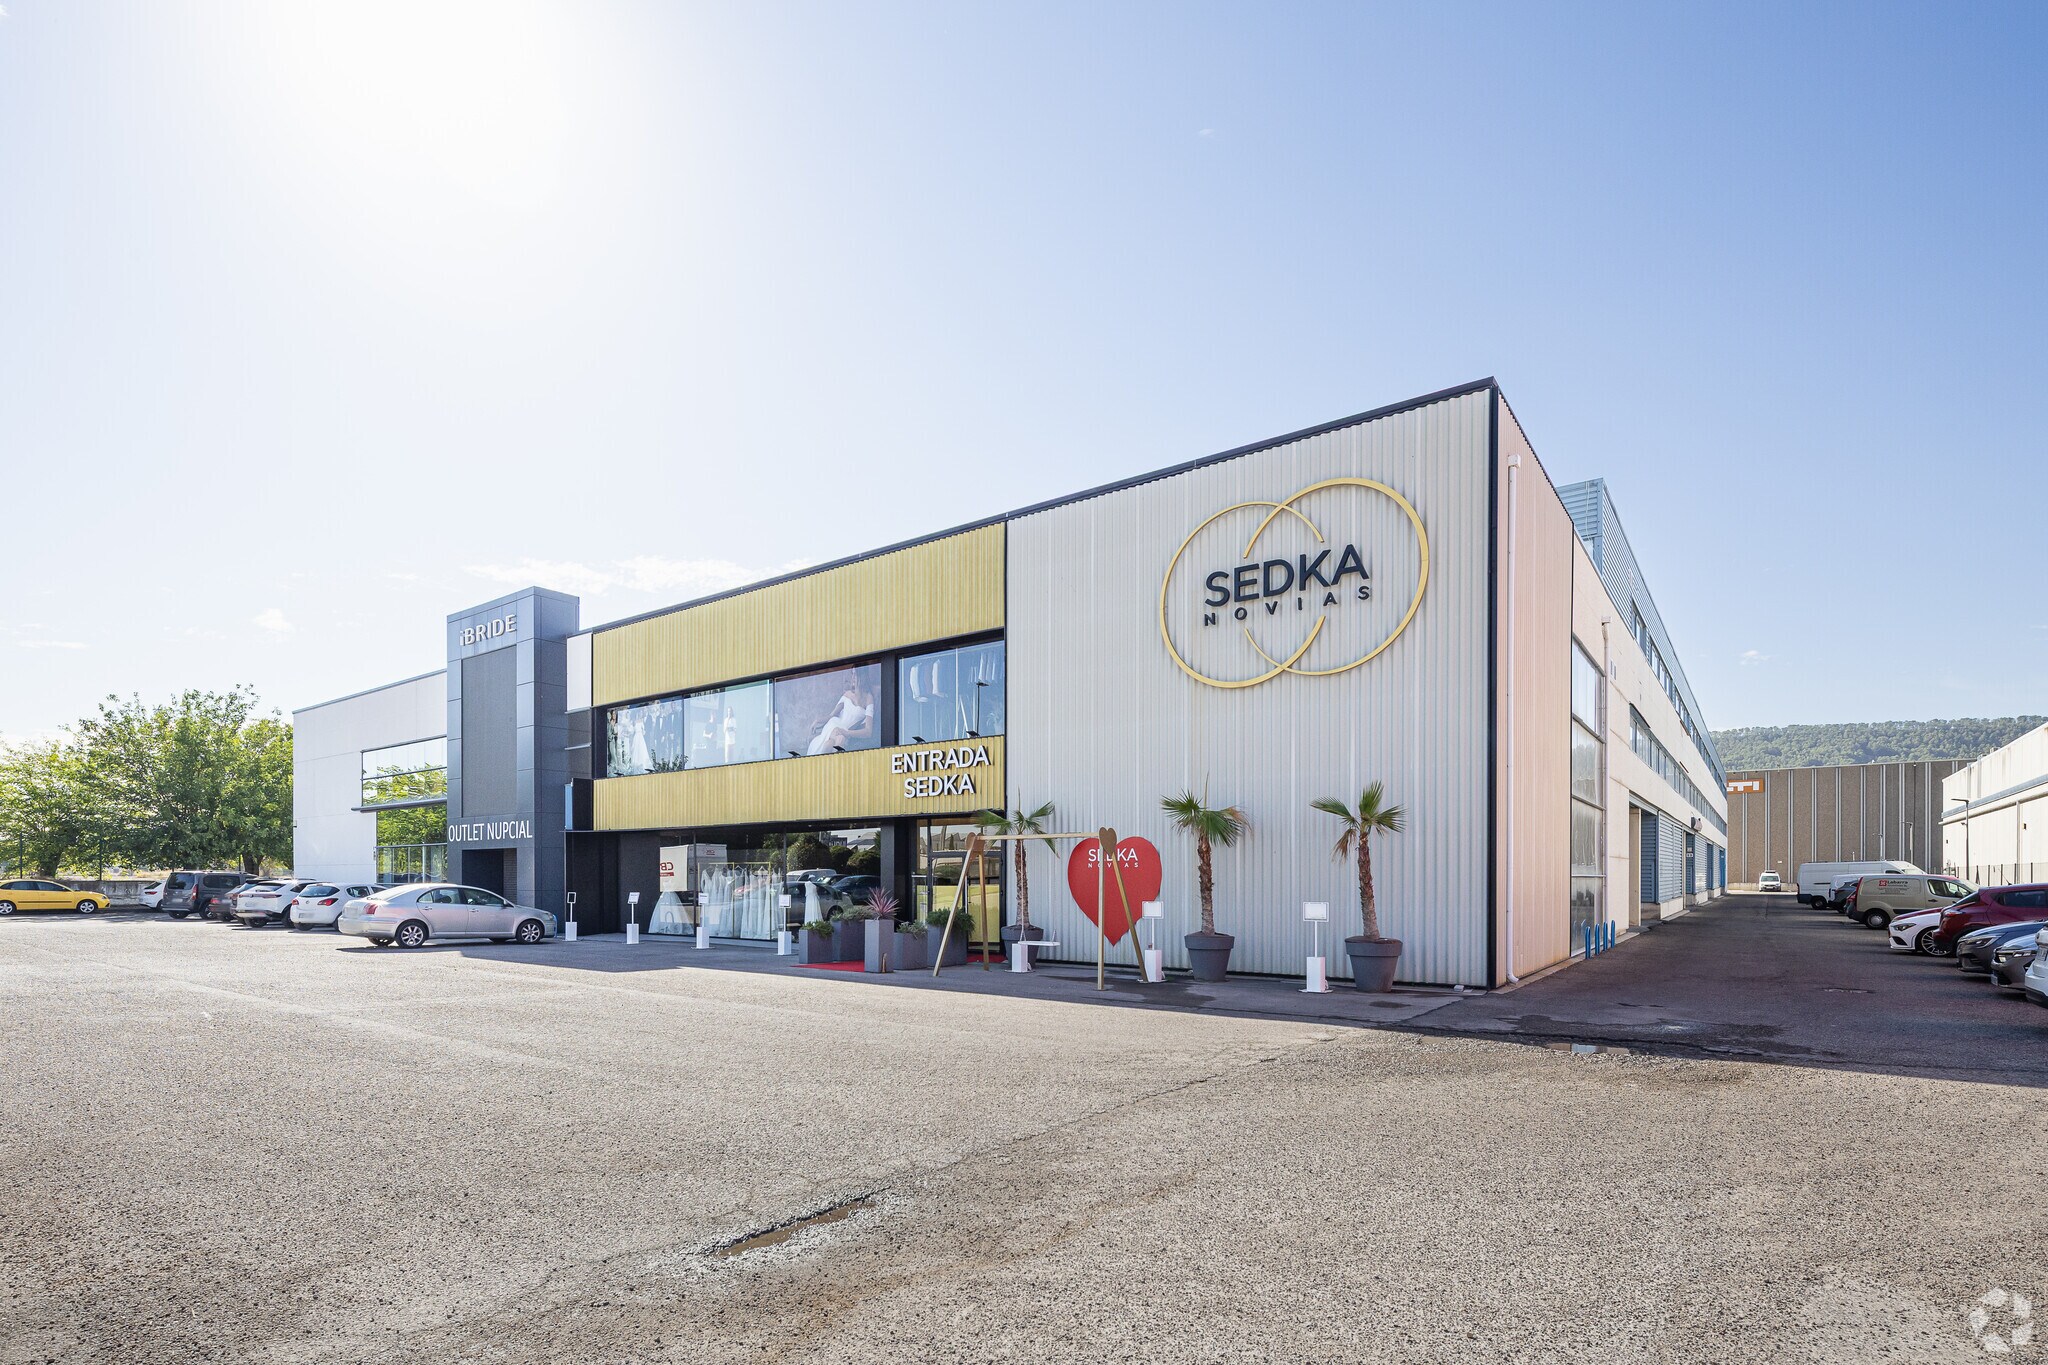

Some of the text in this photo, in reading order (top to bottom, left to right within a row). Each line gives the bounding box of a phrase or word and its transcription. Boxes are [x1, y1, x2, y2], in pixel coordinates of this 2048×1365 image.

[1204, 543, 1370, 608] SEDKA
[1204, 585, 1370, 627] NOVIAS
[460, 613, 517, 646] iBRIDE
[891, 744, 991, 774] ENTRADA
[903, 773, 976, 799] SEDKA
[1726, 781, 1760, 792] TI
[448, 820, 533, 842] OUTLET NUPCIAL
